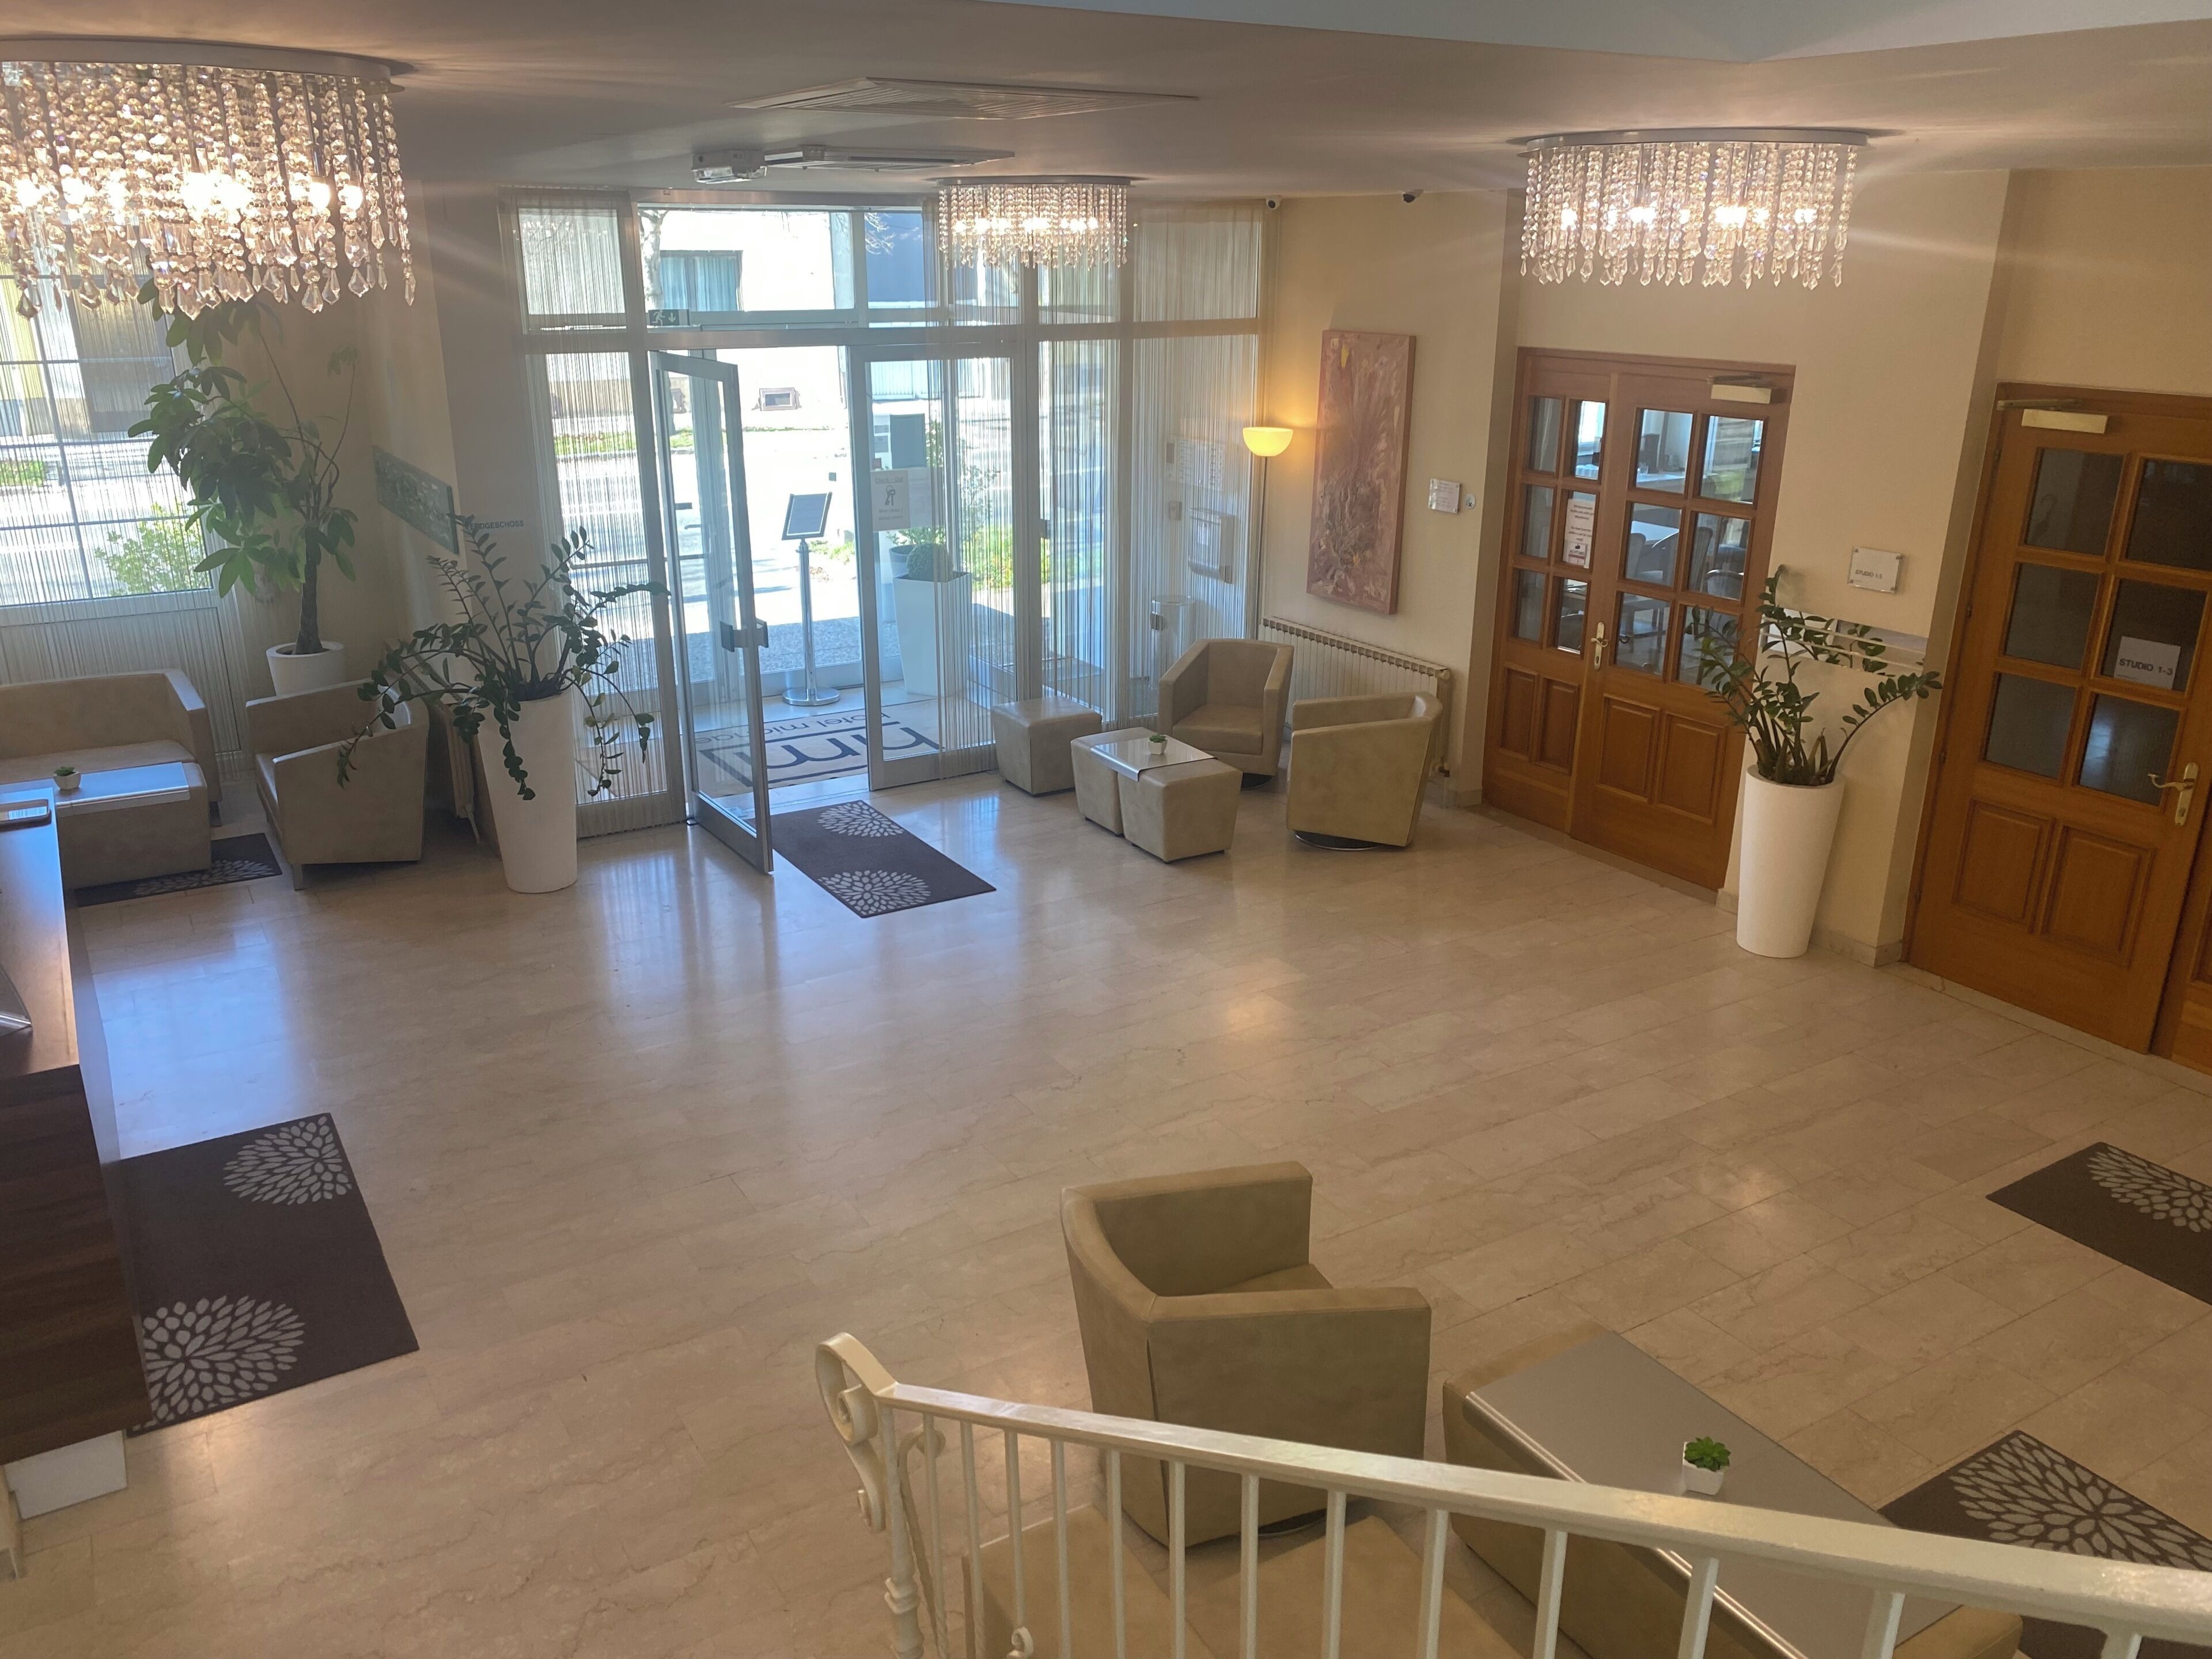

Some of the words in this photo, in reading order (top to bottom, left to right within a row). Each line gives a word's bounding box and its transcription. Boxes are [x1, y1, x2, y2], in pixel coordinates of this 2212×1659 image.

[470, 520, 524, 529] ERDGESCHOSS
[2119, 658, 2154, 671] STUDIO
[2158, 666, 2173, 675] 1-3
